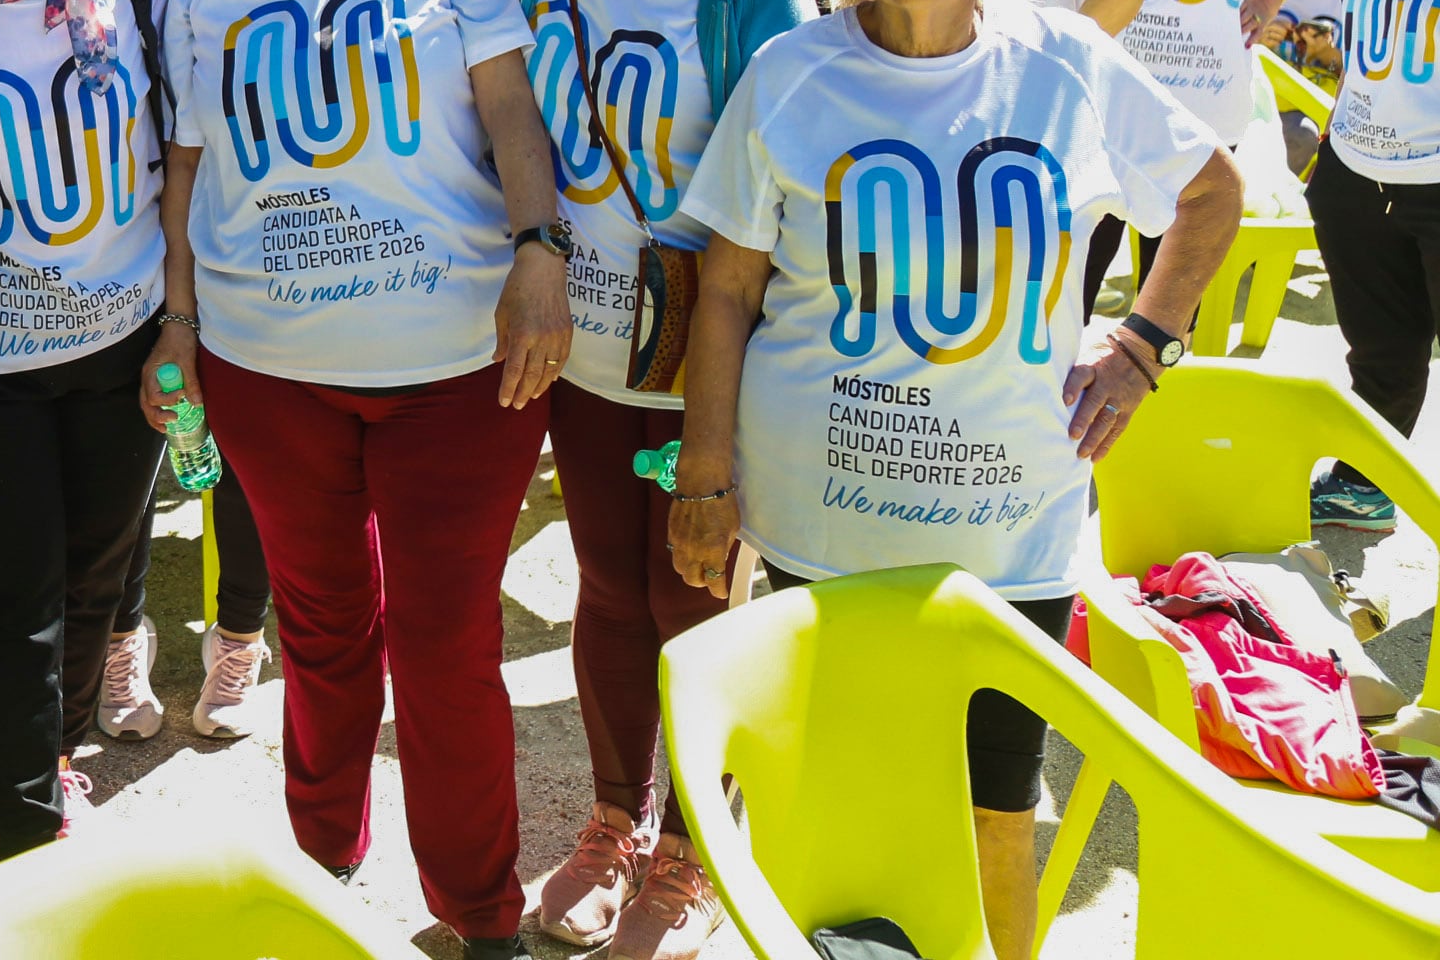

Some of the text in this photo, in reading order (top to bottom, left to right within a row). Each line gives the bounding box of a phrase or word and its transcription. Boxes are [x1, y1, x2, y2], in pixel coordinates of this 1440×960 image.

[1126, 24, 1193, 42] CANDIDATA A
[1134, 11, 1180, 27] ÓSTOLES
[1123, 36, 1214, 57] CIUDAD EUROPEA
[1126, 49, 1222, 69] EL DEPORTE 2026
[256, 187, 331, 211] MÓSTOLES
[264, 204, 361, 232] CANDIDATA A
[263, 218, 404, 252] CIUDAD EUROPEA
[264, 235, 425, 273] DEL DEPORTE 2026
[589, 249, 599, 264] A
[77, 281, 89, 296] A
[268, 254, 452, 304] We make it big!
[0, 281, 124, 313] CIUDAD EUROPEA
[0, 283, 142, 330] DEL DEPORTE 2026
[568, 282, 635, 311] ORTE 20
[43, 328, 105, 352] make
[110, 316, 127, 335] it
[571, 313, 633, 339] ake it
[833, 374, 931, 407] MÓSTOLES
[829, 403, 961, 437] CANDIDATA A
[828, 427, 1006, 462] CIUDAD EUROPEA
[828, 449, 1022, 485] DEL DEPORTE 2026
[823, 476, 1045, 531] We make it big!
